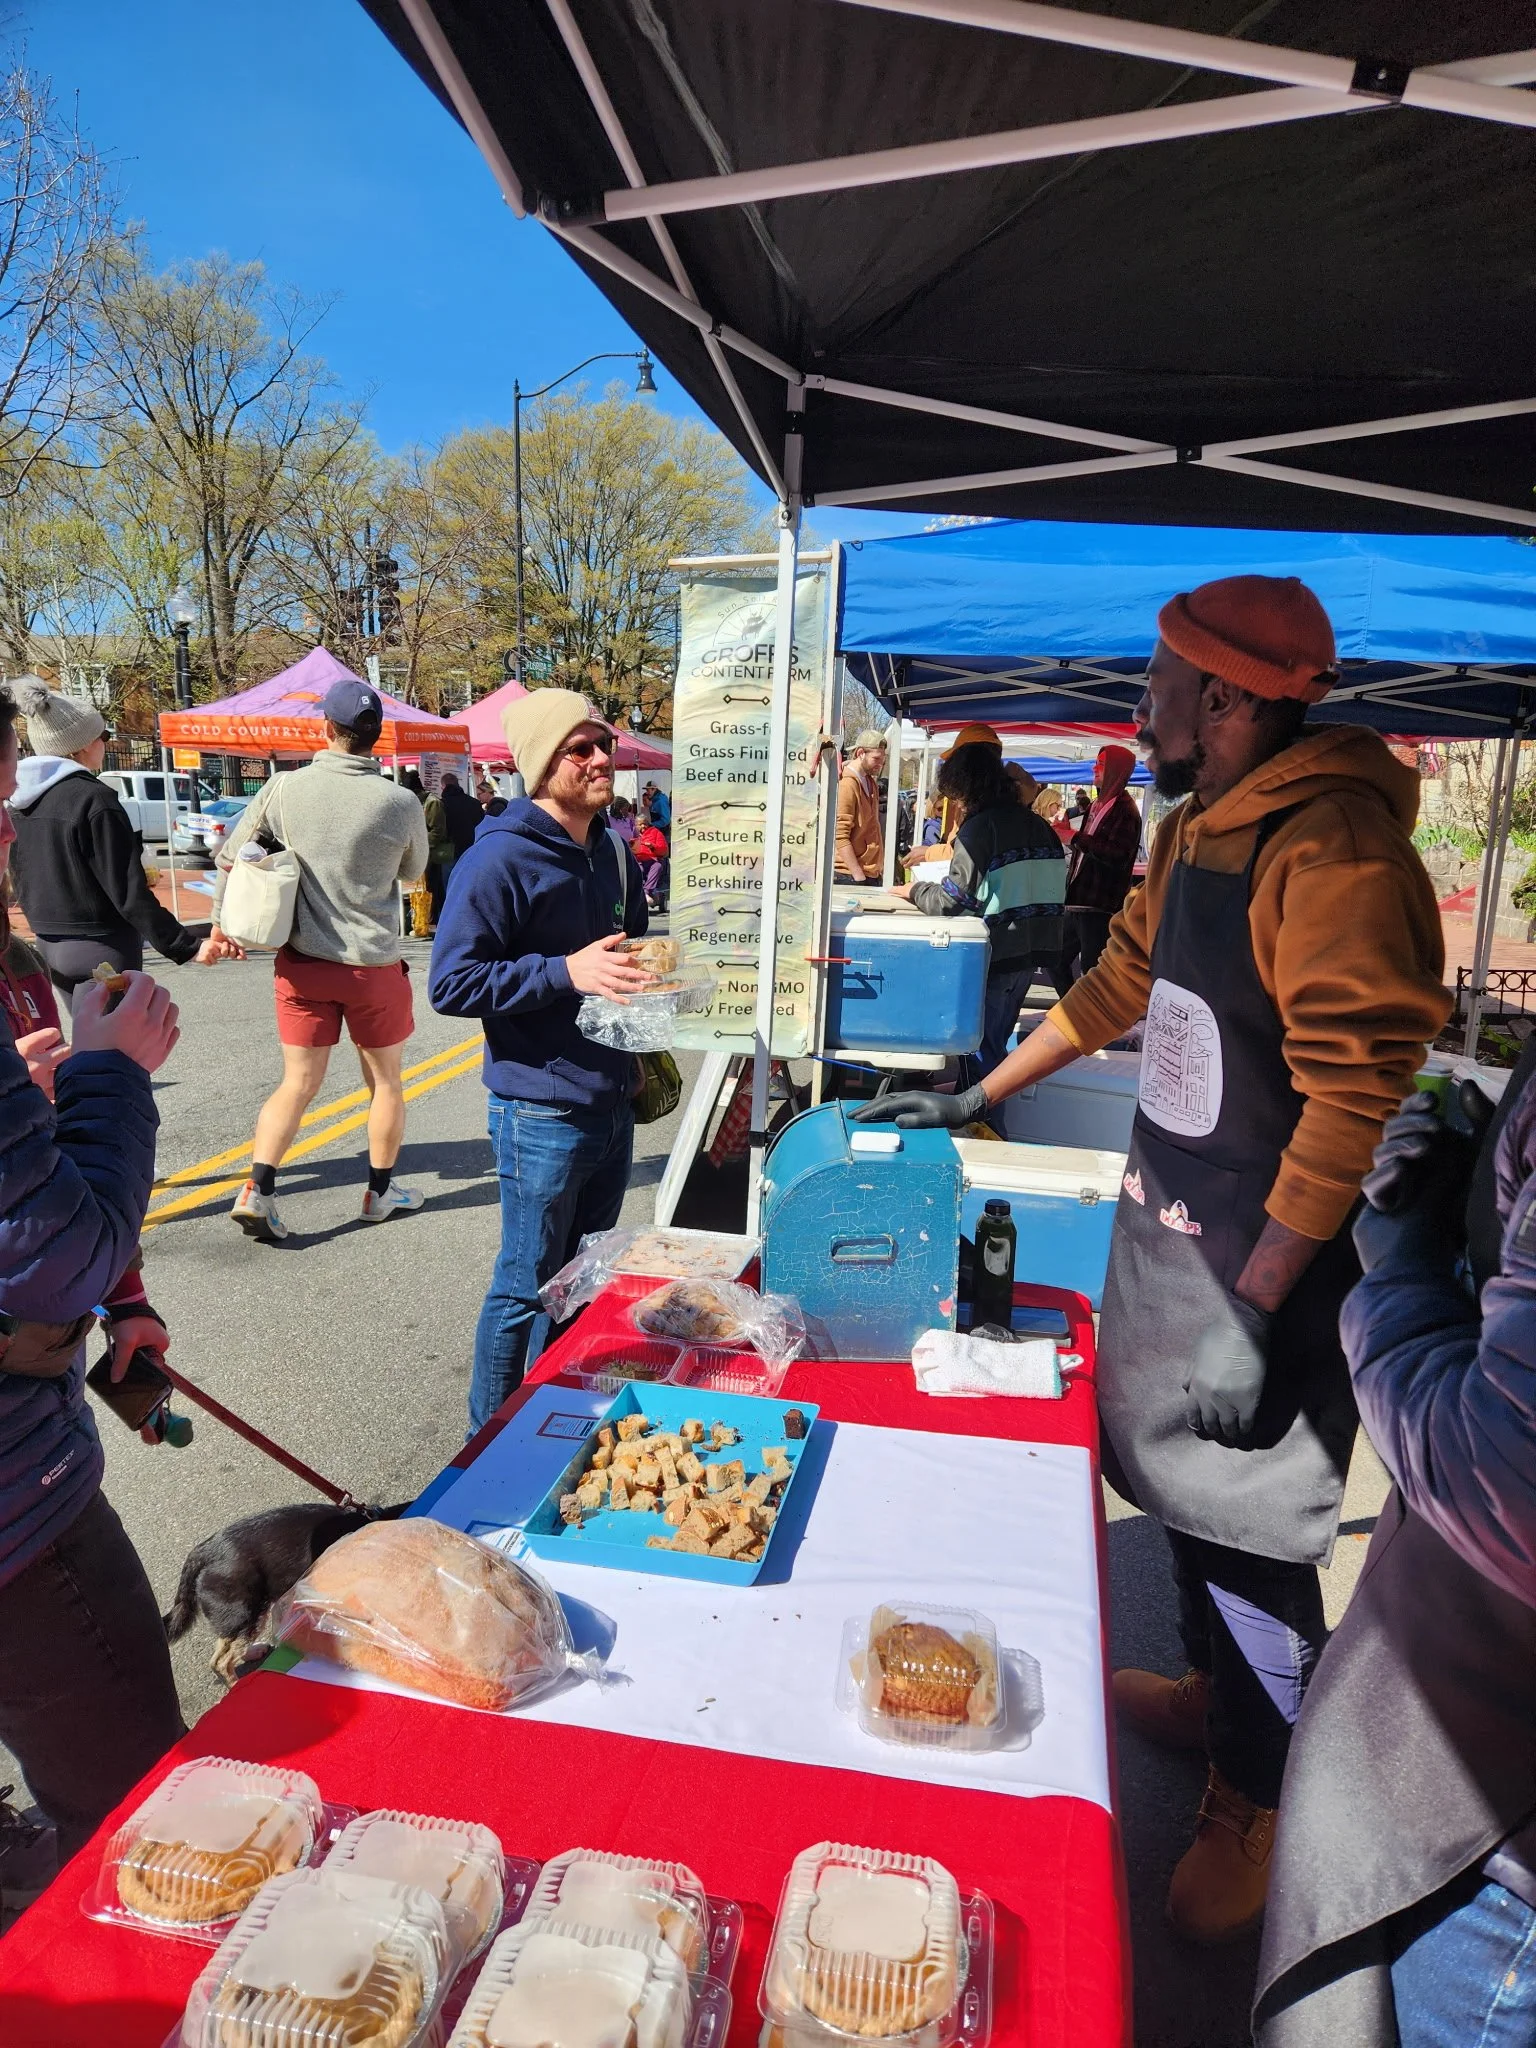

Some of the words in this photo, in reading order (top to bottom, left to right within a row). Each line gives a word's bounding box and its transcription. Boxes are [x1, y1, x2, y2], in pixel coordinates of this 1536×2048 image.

[701, 644, 799, 665] GROFFS
[691, 665, 765, 679] CONTENT
[768, 667, 811, 681] FRM
[180, 724, 221, 736] COLD
[227, 725, 302, 738] COUNTRY
[711, 720, 771, 736] Grass-f
[690, 744, 735, 759] Grass
[740, 746, 807, 762] Finied
[686, 768, 724, 783] Beef
[727, 770, 757, 784] and
[762, 771, 806, 785] Lmb
[687, 828, 749, 843] Pasture
[753, 830, 806, 845] Rsed
[699, 852, 759, 870] Poultry
[687, 875, 763, 891] Berkshire
[779, 877, 804, 892] ork
[689, 929, 794, 946] Regenerave
[719, 1002, 753, 1016] Free
